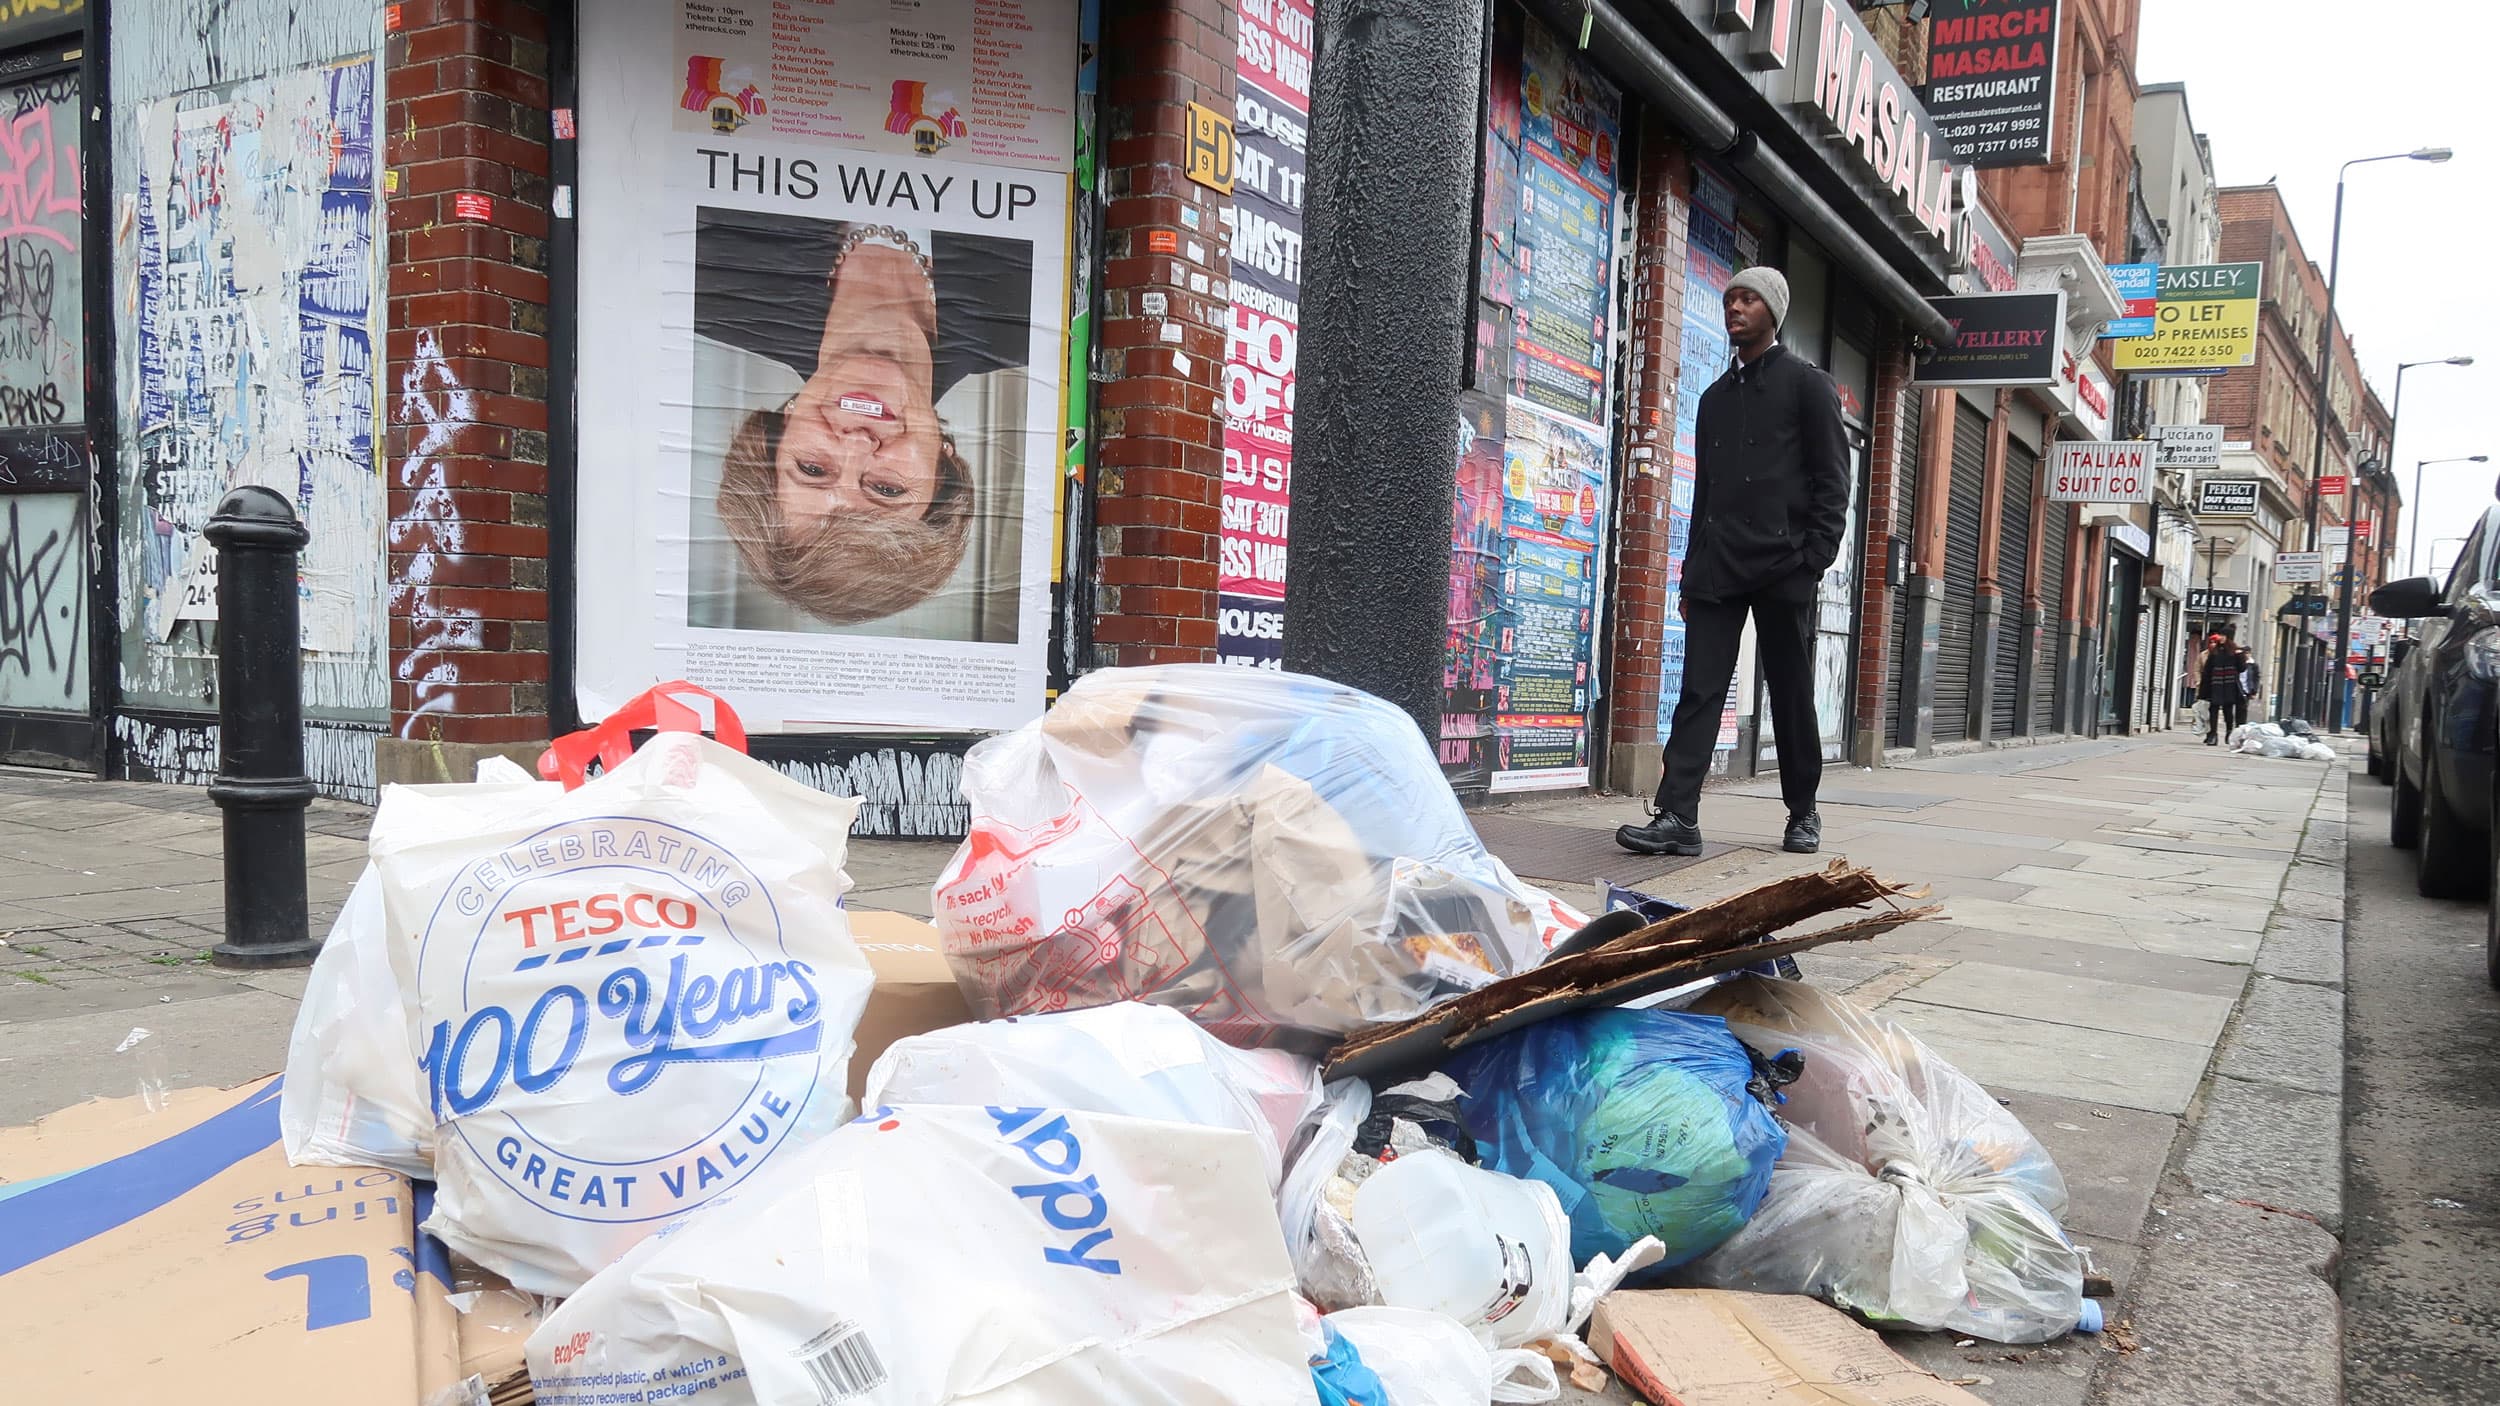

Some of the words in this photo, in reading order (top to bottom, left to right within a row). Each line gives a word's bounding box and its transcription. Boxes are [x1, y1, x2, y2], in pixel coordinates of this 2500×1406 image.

[686, 3, 715, 13] Midday
[722, 7, 744, 16] 10pm
[685, 23, 747, 36] xthetracks.com
[789, 24, 811, 33] Bond
[890, 28, 919, 39] Midday
[926, 32, 946, 41] 10pm
[1934, 6, 2051, 46] MIRCH
[772, 42, 797, 53] Poppy
[1931, 41, 2047, 79] MASALA
[772, 73, 803, 84] Norman
[1933, 76, 2041, 103] RESTAURANT
[772, 126, 811, 135] Independent
[1202, 119, 1210, 137] 9
[1814, 2, 1953, 253] MASALA
[1979, 121, 2008, 135] 7247
[2011, 117, 2041, 132] 9992
[1977, 140, 2006, 153] 7377
[2009, 136, 2039, 150] 0155
[1201, 154, 1209, 171] 9
[696, 148, 820, 200] THIS
[838, 164, 954, 213] WAY
[971, 178, 1037, 221] UP
[2156, 305, 2180, 323] O
[2189, 304, 2225, 322] LET
[2172, 327, 2249, 341] PREMISES
[2015, 352, 2029, 360] LTD
[2134, 347, 2159, 358] 020
[2163, 345, 2196, 357] 7422
[2200, 345, 2234, 356] 6350
[1225, 364, 1283, 422] OF
[2194, 445, 2213, 453] act
[1223, 448, 1258, 487] DJ
[2063, 452, 2142, 469] ITALIAN
[2178, 455, 2197, 464] 7247
[2197, 455, 2217, 464] 3817
[2057, 476, 2102, 493] SUIT
[2109, 477, 2144, 494] CO.
[2208, 484, 2252, 496] PERFECT
[2204, 496, 2223, 504] OUT
[2225, 496, 2253, 505] SIZES
[1222, 494, 1256, 534] SAT
[199, 555, 218, 576] SU
[1217, 607, 1284, 640] HOUSE
[1457, 713, 1477, 736] NOW
[1440, 740, 1470, 764] UK.COM
[455, 829, 751, 917] CELEBRATING
[958, 885, 992, 906] sack
[503, 892, 698, 950] TESCO
[418, 984, 590, 1128] 100
[597, 953, 825, 1097] Years
[496, 1136, 638, 1209] GREAT
[660, 1089, 792, 1200] VALUE
[580, 1372, 614, 1388] recycled
[614, 1369, 650, 1386] plastic,
[652, 1365, 667, 1381] of
[671, 1358, 712, 1380] which
[717, 1354, 727, 1366] a
[596, 1391, 643, 1406] recovered
[647, 1378, 718, 1402] packaging
[721, 1367, 748, 1385] was
